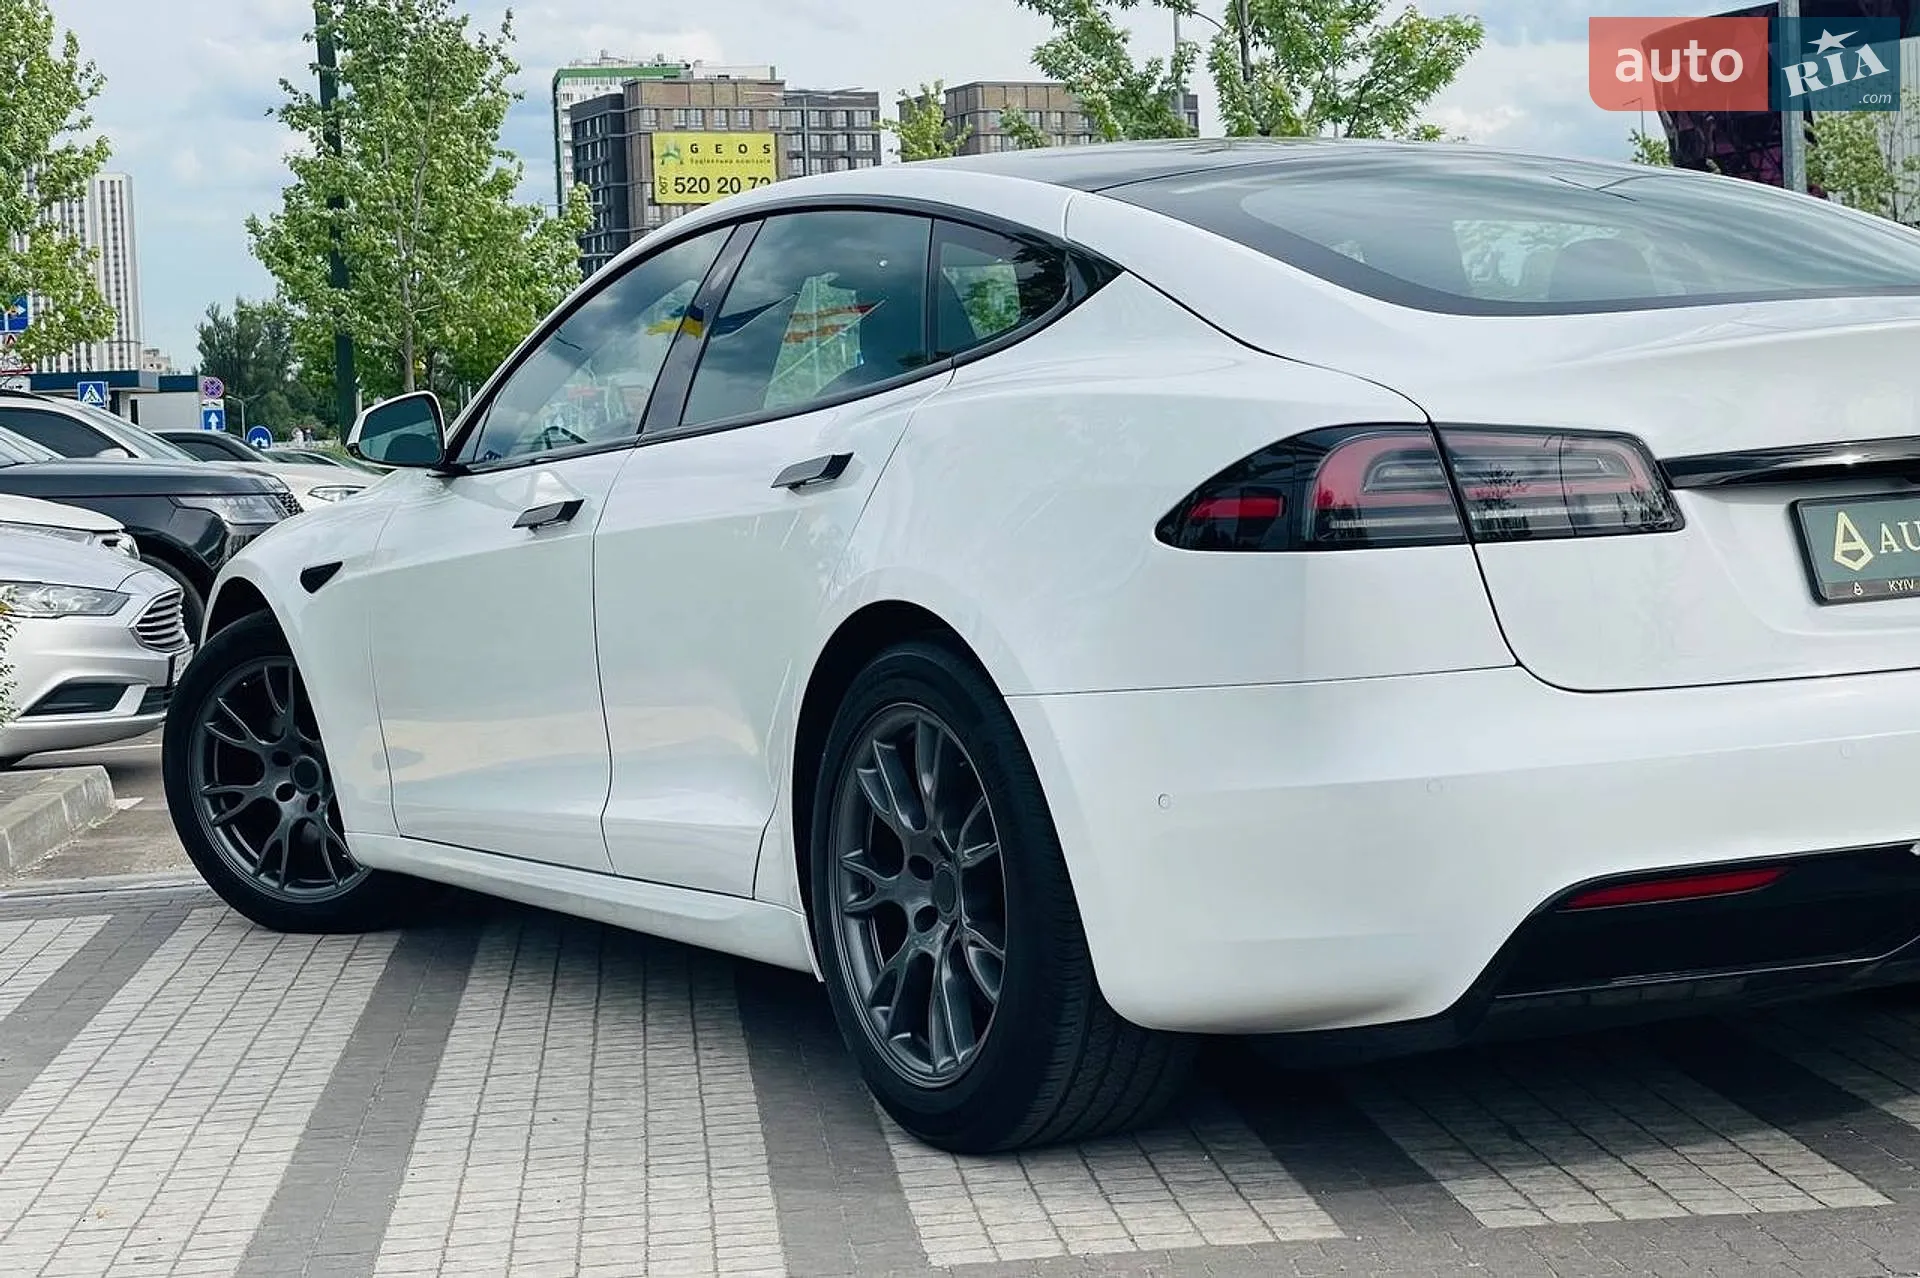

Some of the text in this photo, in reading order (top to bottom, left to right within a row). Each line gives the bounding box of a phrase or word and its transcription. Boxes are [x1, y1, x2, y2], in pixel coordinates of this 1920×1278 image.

[690, 143, 771, 154] GEOS
[674, 176, 711, 195] 520
[717, 176, 741, 195] 20
